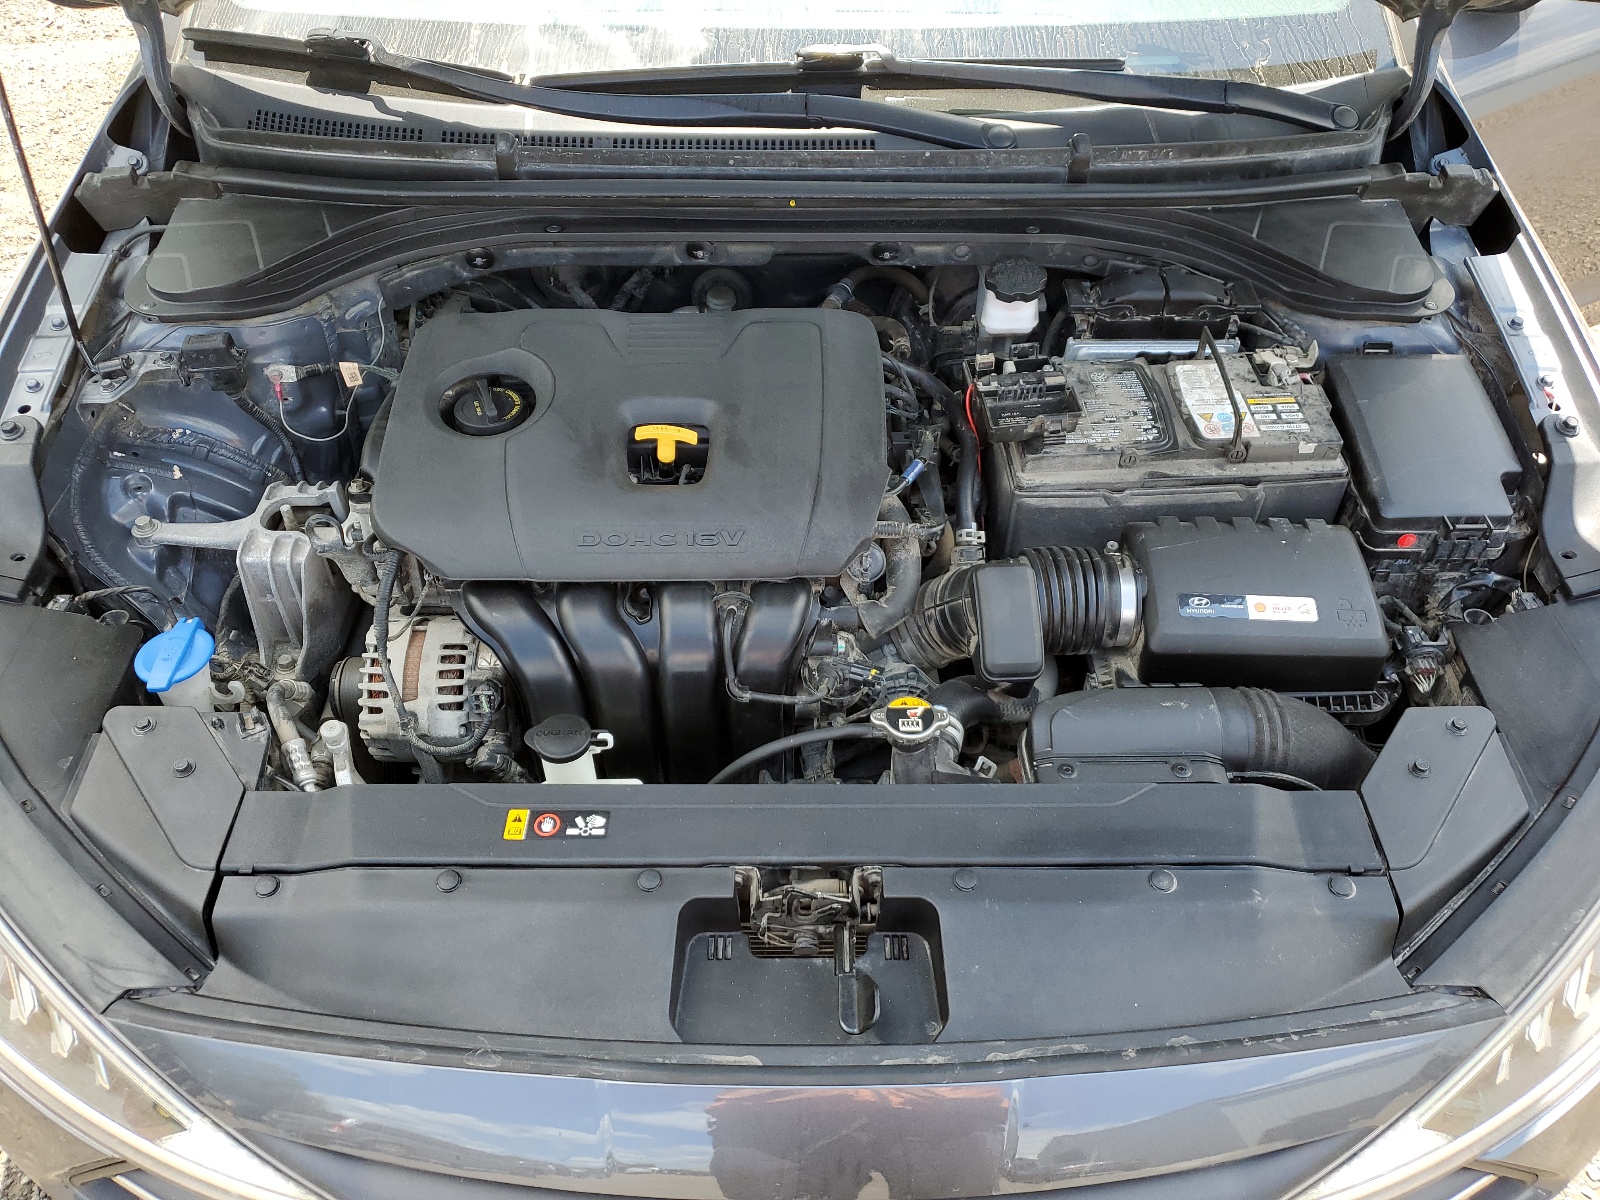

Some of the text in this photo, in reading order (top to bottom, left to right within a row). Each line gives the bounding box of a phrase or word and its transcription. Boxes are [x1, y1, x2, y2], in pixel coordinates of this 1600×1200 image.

[577, 530, 746, 547] DOHC 16V
[536, 729, 588, 737] COOLANT
